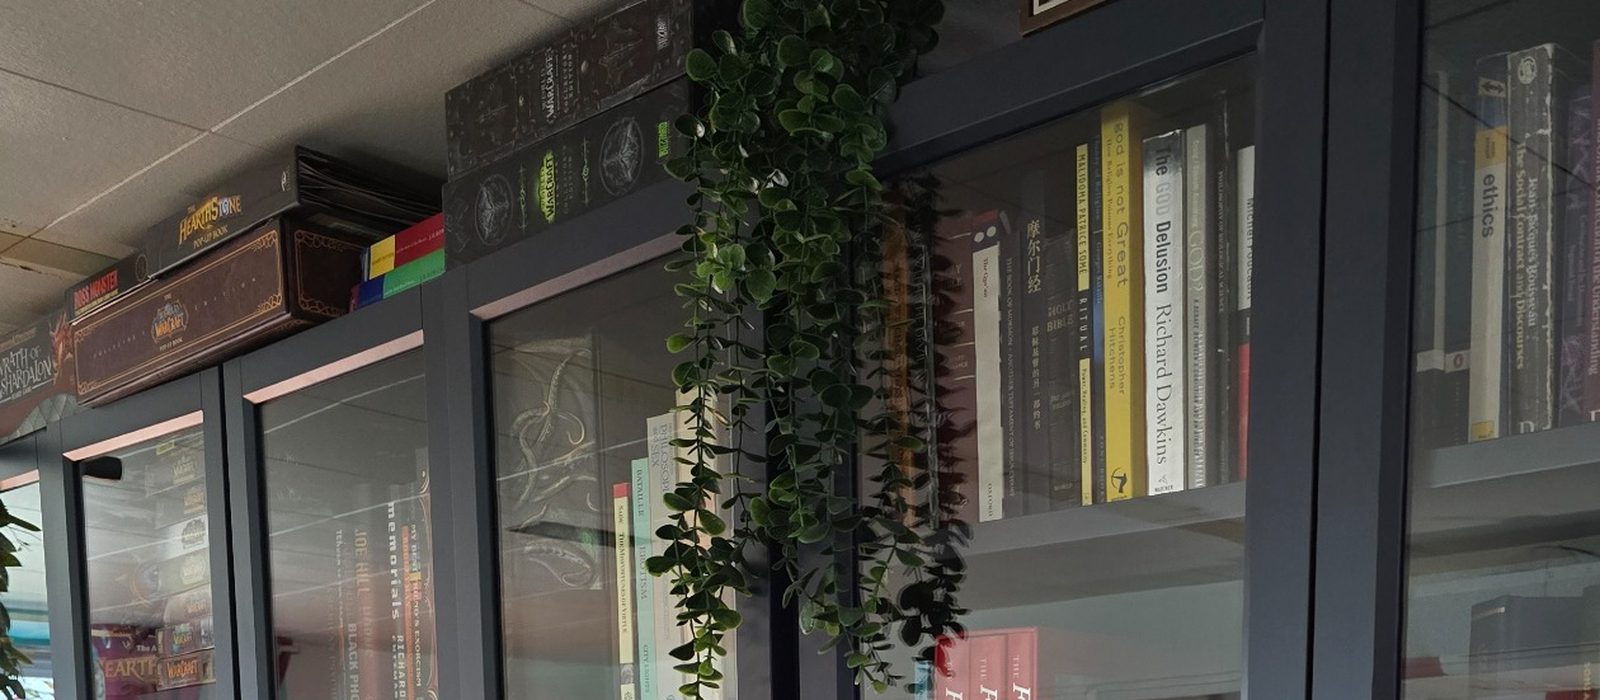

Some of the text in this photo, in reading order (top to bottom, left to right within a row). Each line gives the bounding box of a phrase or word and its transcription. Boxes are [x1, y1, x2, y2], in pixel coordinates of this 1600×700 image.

[546, 55, 555, 119] WARCRAFT
[546, 157, 554, 218] WARCRAFT
[1079, 154, 1088, 205] MALIDOMA
[1114, 123, 1130, 289] god is not Great
[1482, 174, 1498, 238] ethics
[1516, 170, 1528, 211] Social
[1027, 219, 1041, 294] 摩尔门经
[1079, 208, 1088, 247] PATRICE
[1105, 232, 1115, 280] Everything
[1516, 216, 1528, 271] Contract
[1188, 230, 1206, 292] GOD?
[1047, 316, 1074, 332] BIBLE
[1048, 301, 1073, 316] HOLY
[1079, 298, 1089, 353] RITUAL
[1155, 145, 1173, 465] The GOD Delusion Richard Dawkins
[1527, 264, 1540, 327] Rousseau
[1007, 309, 1015, 346] MORMON
[1108, 327, 1117, 390] Hitchens
[1117, 316, 1128, 395] Christopher
[1516, 300, 1528, 370] Discourses
[1588, 285, 1600, 375] Understanding
[637, 469, 645, 516] BATAILLE
[355, 529, 370, 599] JOE HILL
[387, 502, 403, 620] memorials
[348, 623, 360, 670] BLACK
[397, 635, 407, 698] RICHARD
